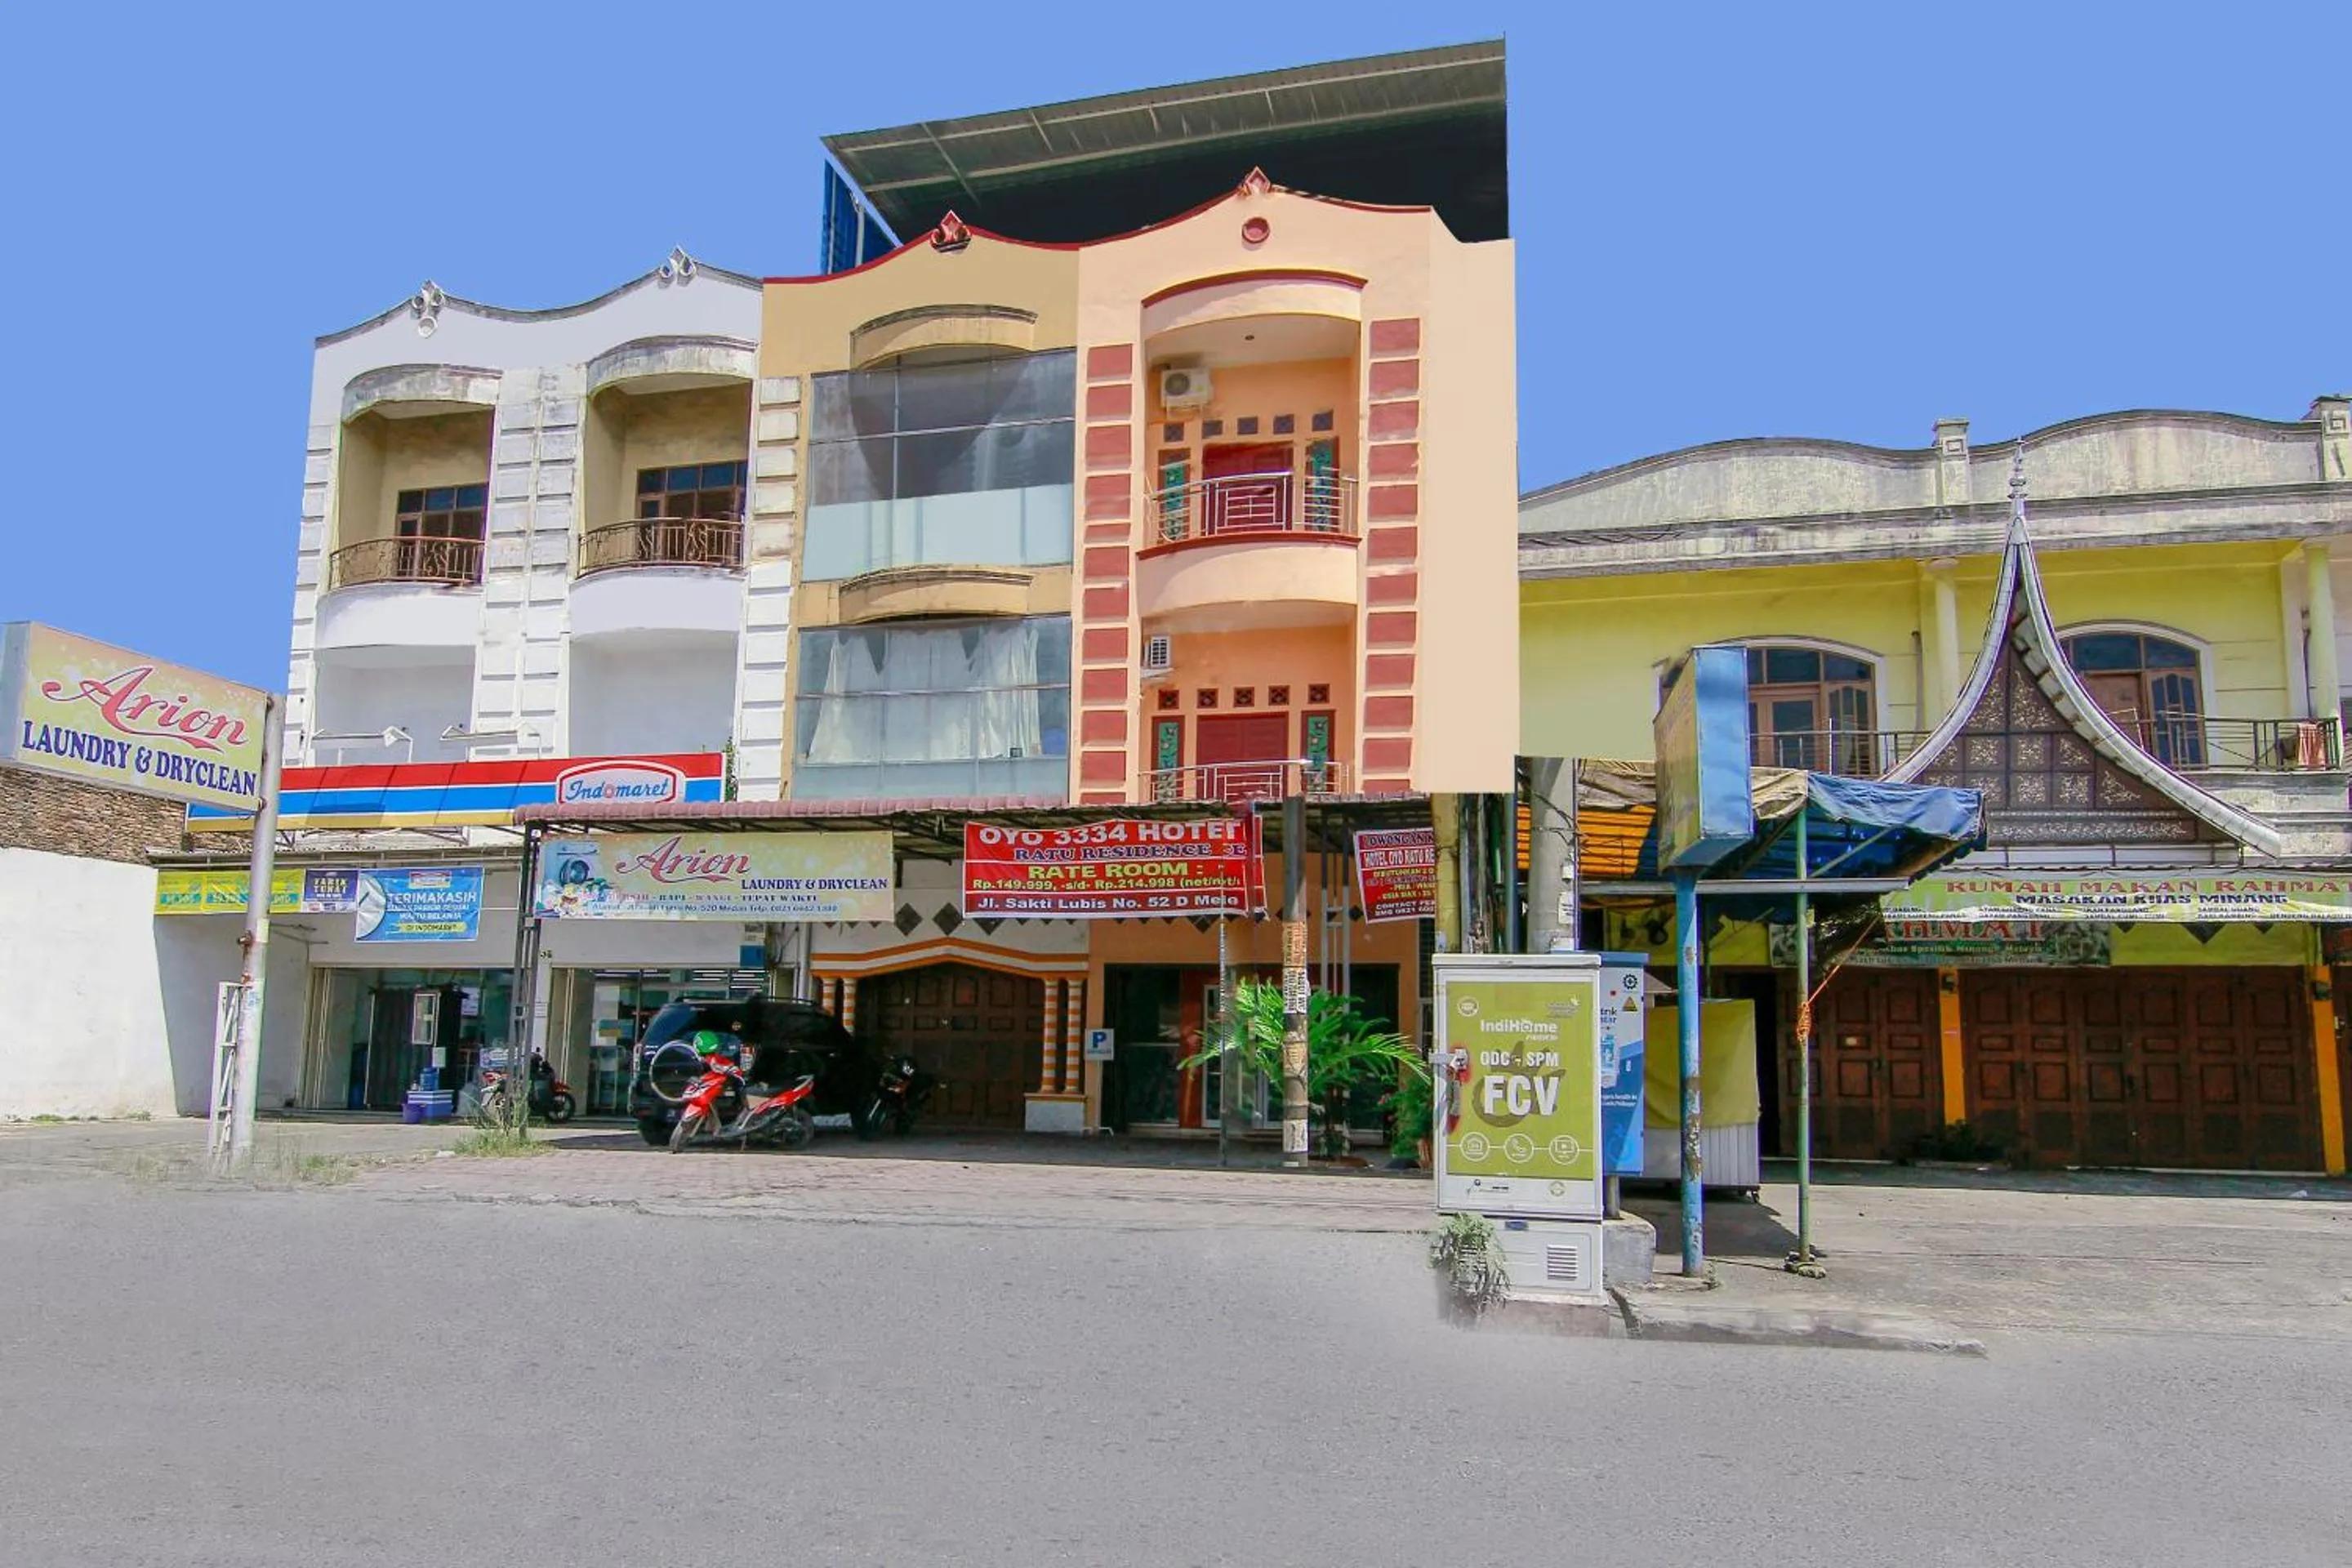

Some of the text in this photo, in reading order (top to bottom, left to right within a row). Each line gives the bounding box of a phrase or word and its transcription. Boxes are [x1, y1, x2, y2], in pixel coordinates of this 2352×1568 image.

[42, 666, 247, 753] Arion
[22, 720, 257, 795] LAUNDRY & DRYCLEAN
[566, 777, 669, 801] Indomaret
[979, 827, 1045, 845] OYO
[1054, 824, 1128, 844] 3334
[616, 835, 751, 883] Arion
[1014, 847, 1075, 861] RATU
[1080, 843, 1211, 859] RESIDENCE
[1365, 851, 1388, 867] HOTEL
[1389, 850, 1404, 866] OYO
[1405, 849, 1424, 865] RATU
[1028, 865, 1097, 880] RATE
[1105, 862, 1188, 879] ROOM
[742, 878, 888, 890] LAUNDRY & DRYCLEAN
[2079, 881, 2198, 893] MAKAN
[387, 891, 478, 904] TERIMAKASIH
[1005, 898, 1052, 909] Sakti
[1058, 897, 1106, 909] Lubis
[1113, 897, 1142, 908] No.
[1148, 897, 1170, 906] 52
[1176, 897, 1188, 906] D
[2016, 893, 2288, 905] MASAKAN KHAS MINANG
[1481, 1019, 1558, 1032] IndiHome
[1093, 1031, 1107, 1049] P
[1481, 1051, 1510, 1066] ODC
[1527, 1051, 1558, 1067] SPM
[1484, 1074, 1560, 1116] FCV
